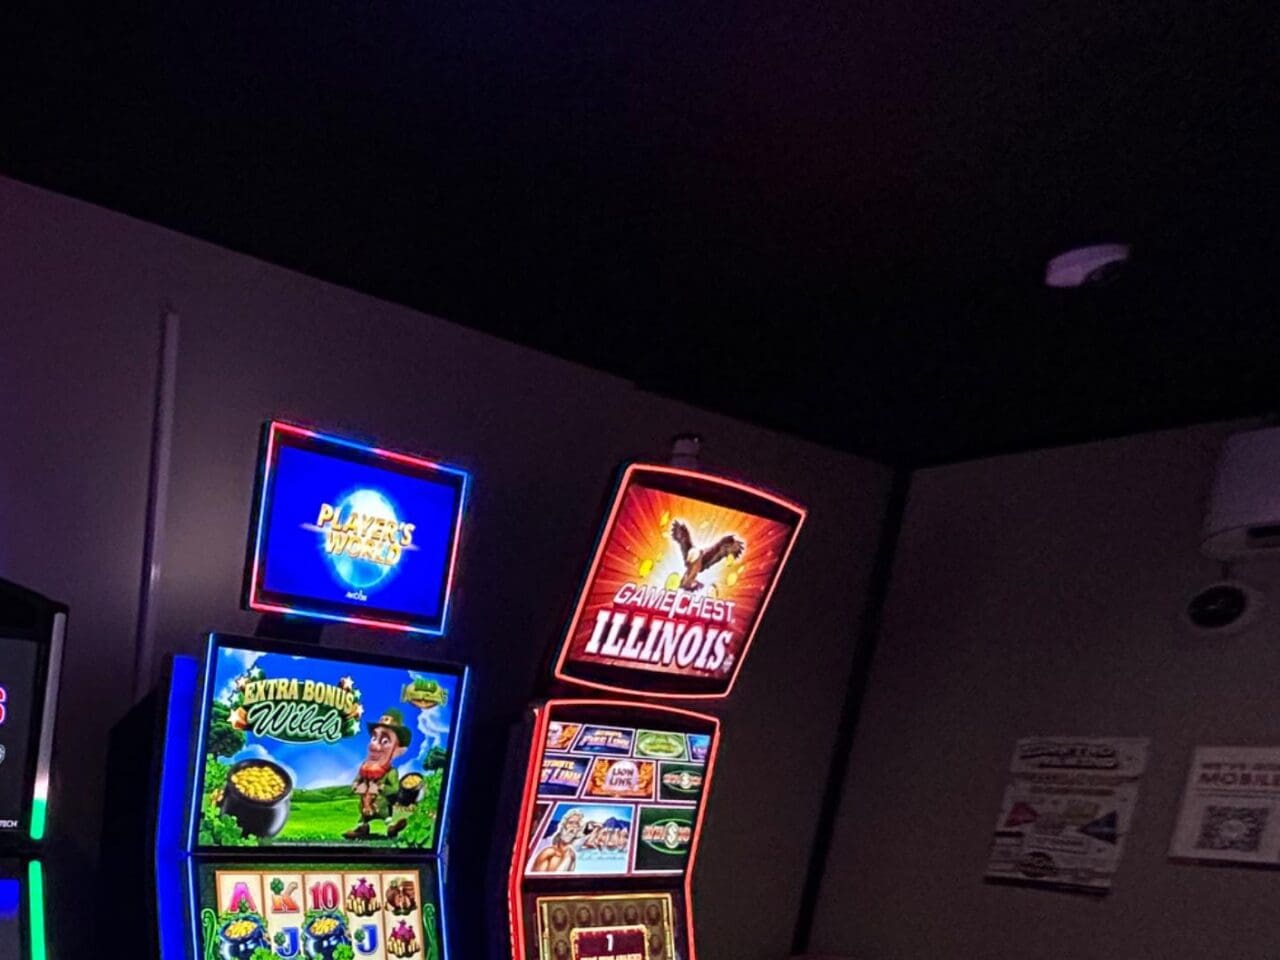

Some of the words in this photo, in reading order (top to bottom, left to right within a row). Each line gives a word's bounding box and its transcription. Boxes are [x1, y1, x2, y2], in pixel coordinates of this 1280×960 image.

[317, 503, 416, 547] PLAYER'S
[326, 531, 403, 566] WORLD
[584, 609, 734, 672] ILLINOIS
[244, 678, 298, 704] EXTRA
[302, 679, 355, 713] BONUS
[247, 701, 343, 742] Wilds
[309, 881, 341, 913] 10
[606, 934, 613, 952] 1
